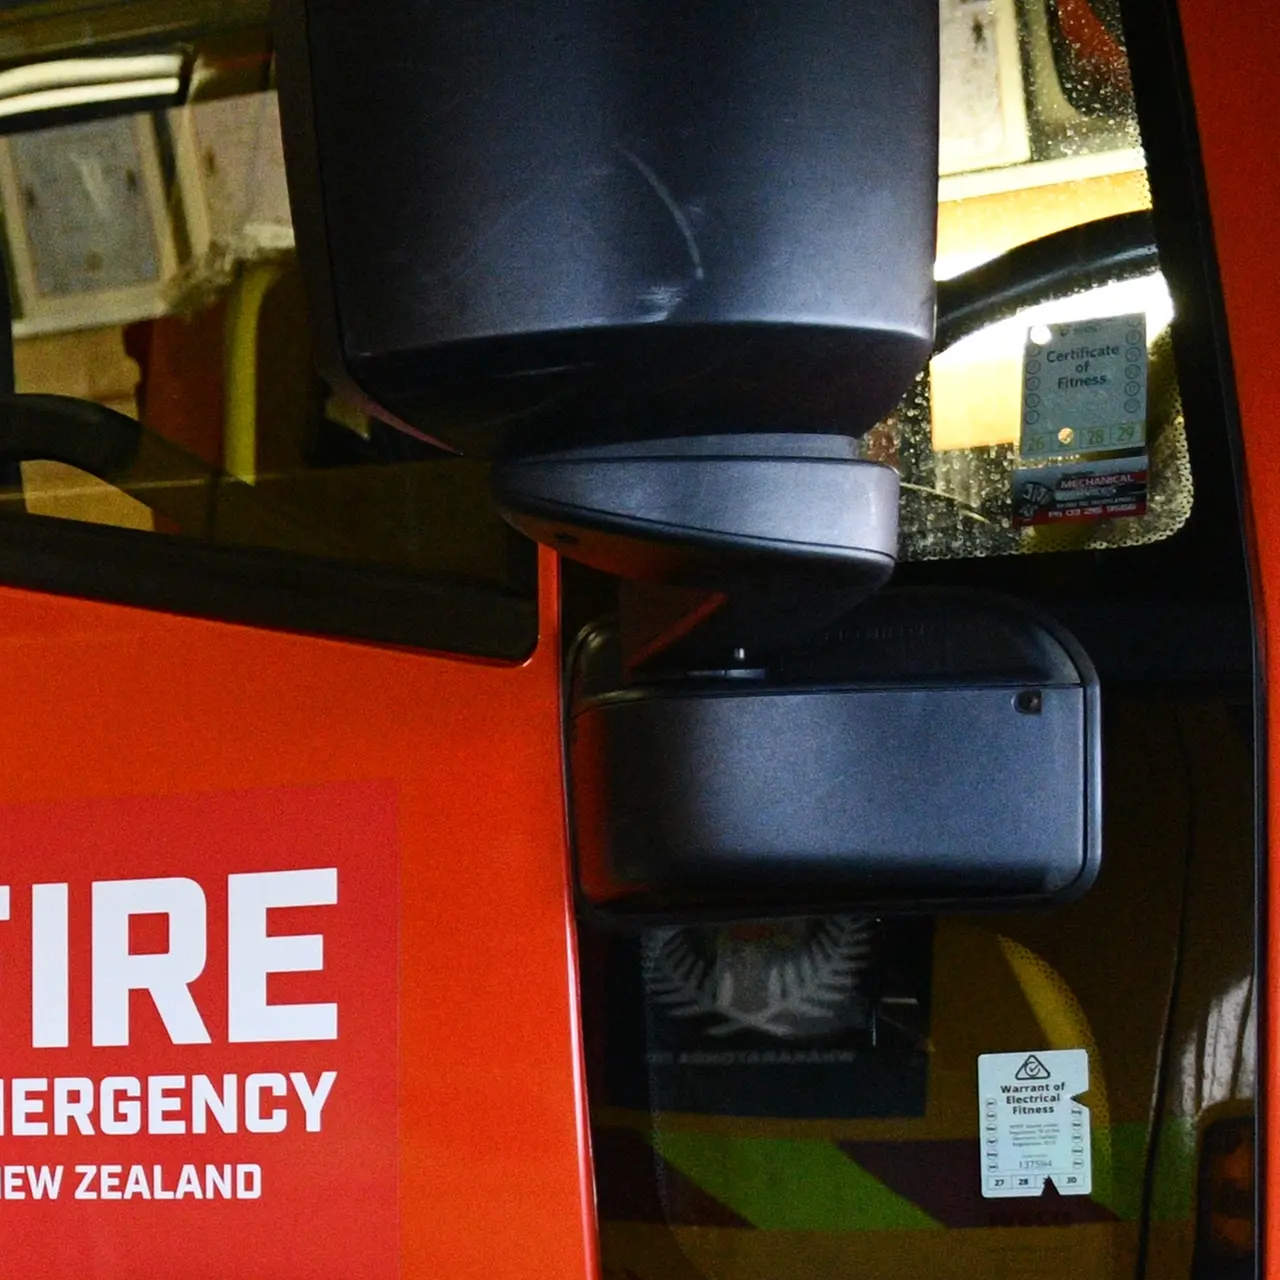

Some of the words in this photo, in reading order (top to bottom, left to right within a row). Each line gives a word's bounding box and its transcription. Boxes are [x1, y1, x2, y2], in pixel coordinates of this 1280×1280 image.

[1046, 344, 1120, 363] Certificate
[1075, 360, 1091, 374] of
[1057, 374, 1107, 389] Fitness
[1000, 1083, 1051, 1094] Warrant
[1053, 1081, 1066, 1092] of
[1005, 1093, 1061, 1105] Electrical
[1012, 1105, 1055, 1116] Fitness
[74, 1163, 263, 1200] ZEALAND
